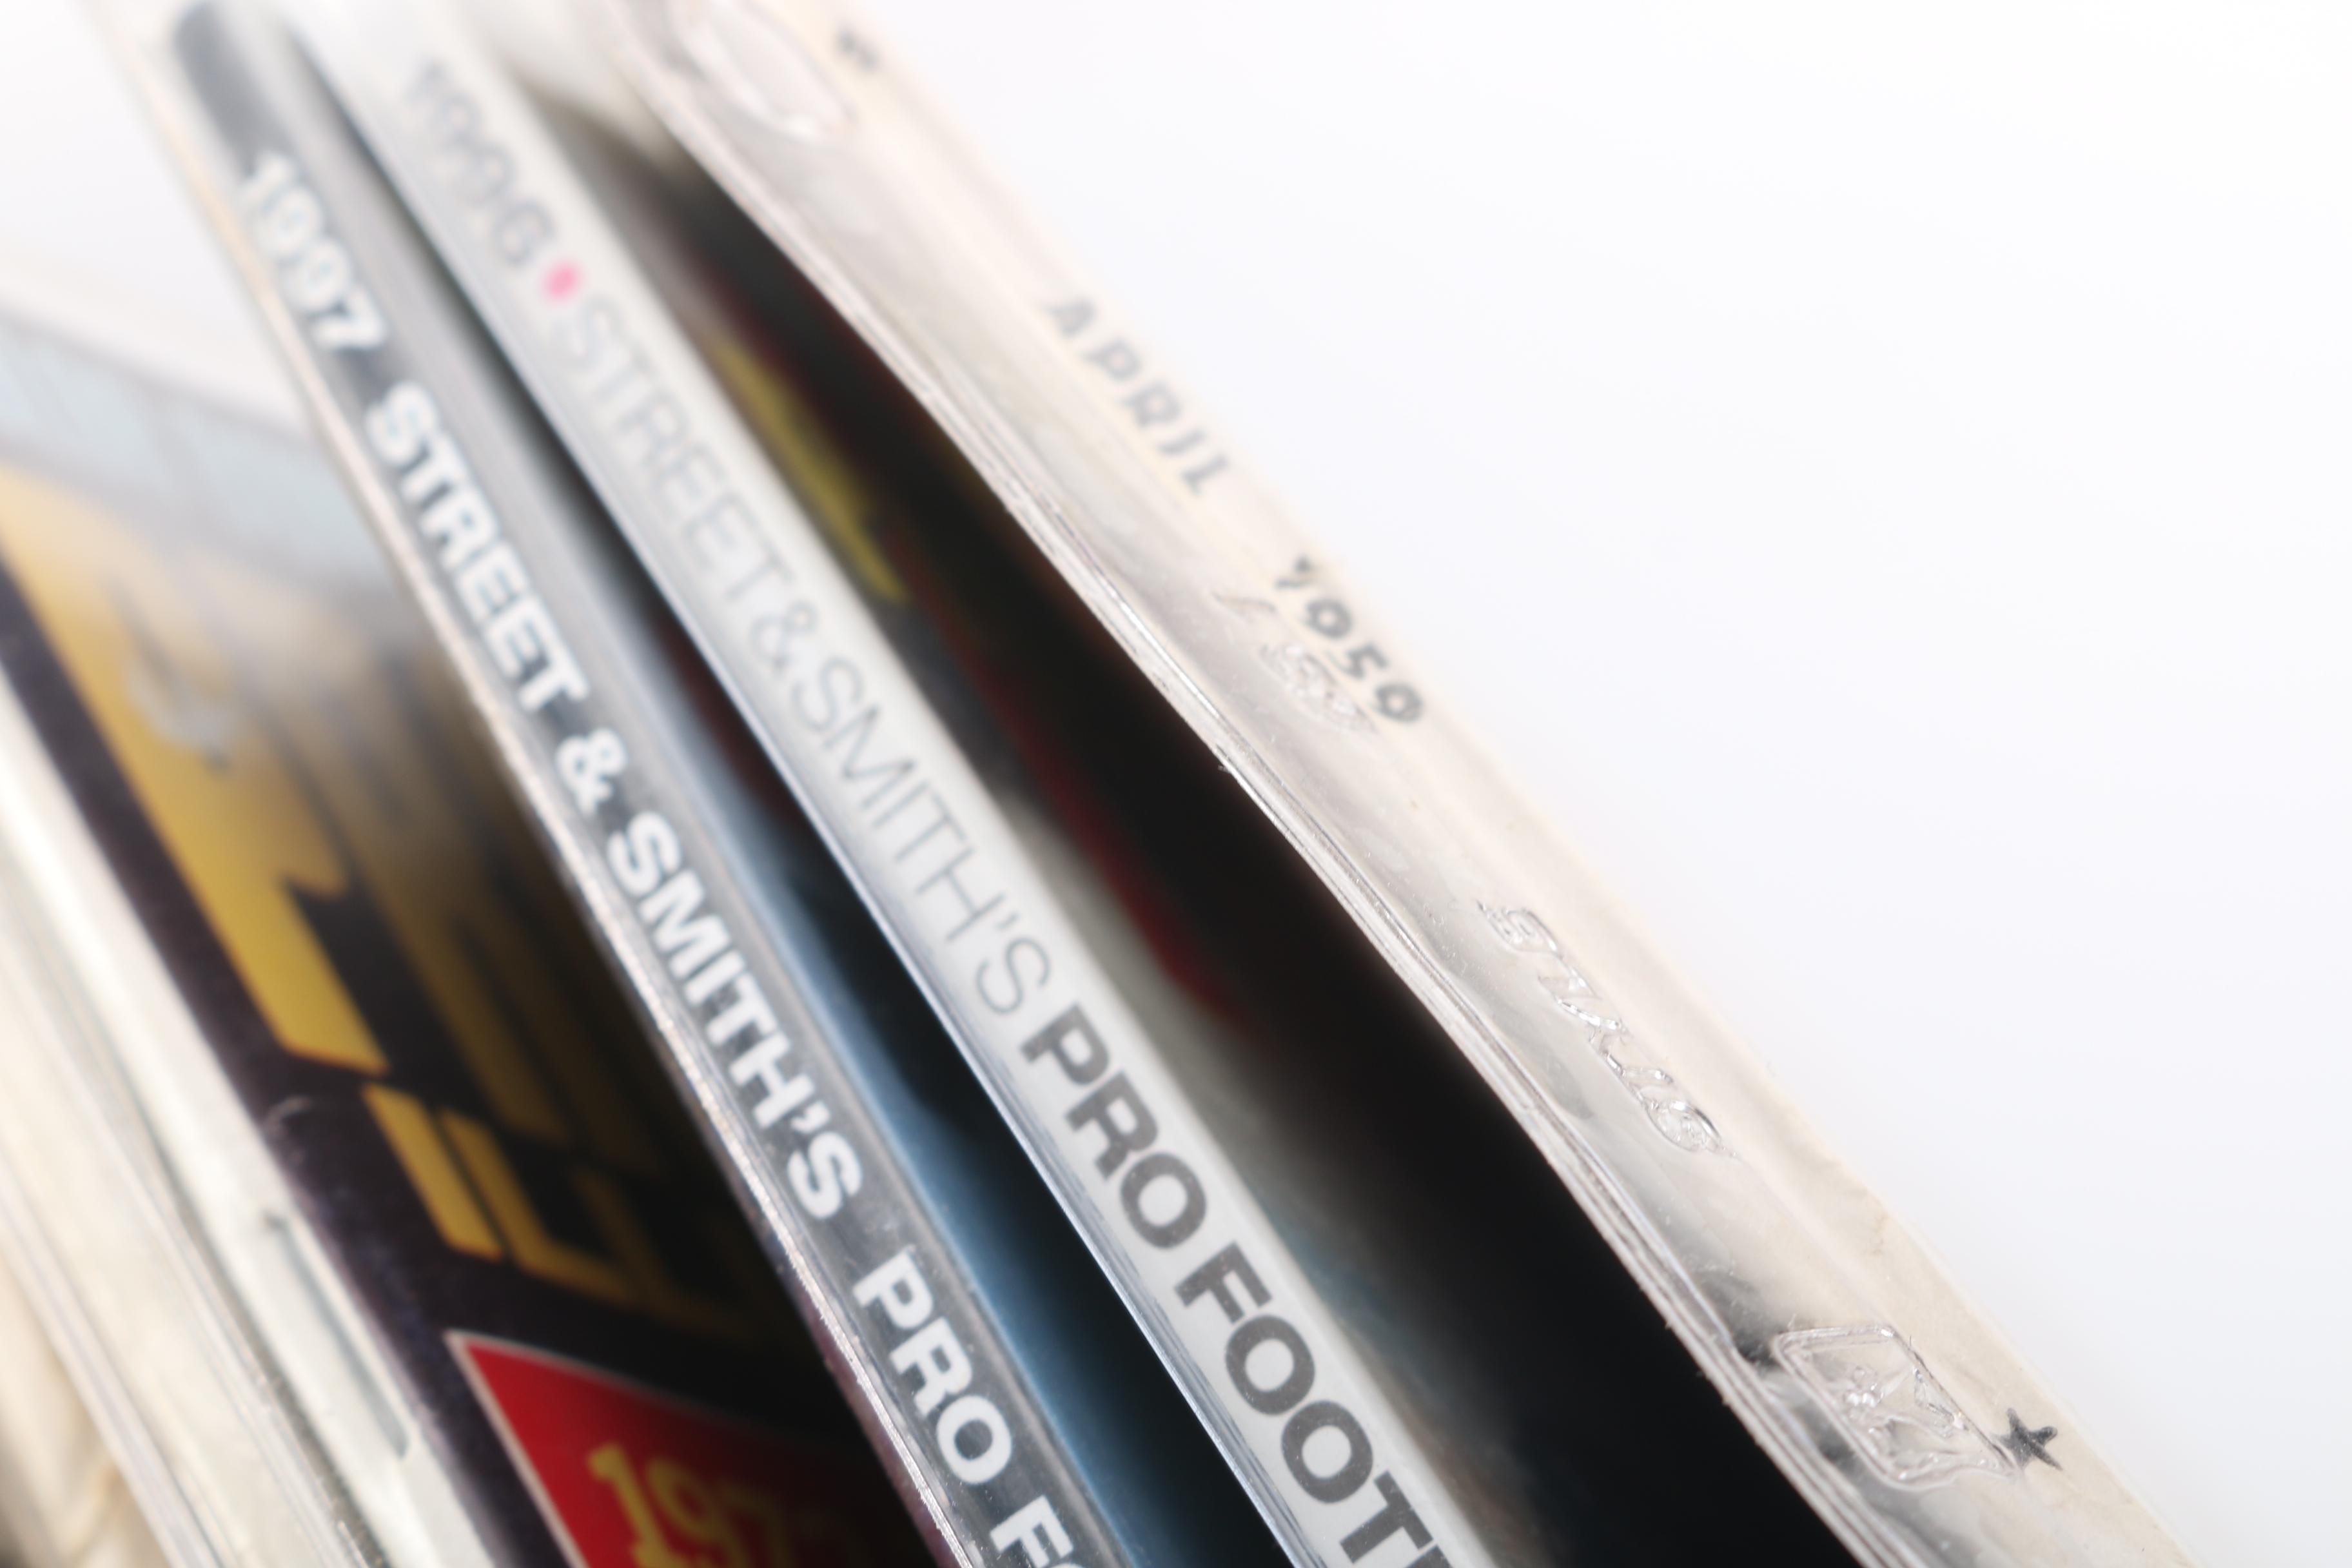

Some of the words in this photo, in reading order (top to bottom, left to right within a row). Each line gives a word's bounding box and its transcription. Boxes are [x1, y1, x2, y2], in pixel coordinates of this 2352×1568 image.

[241, 150, 387, 349] 1997
[365, 381, 590, 712] STREET
[554, 727, 628, 816] &
[606, 811, 863, 1220] SMITH'S
[852, 1251, 1013, 1484] PRO
[407, 59, 556, 264] 1996
[550, 292, 794, 603] STREET
[1019, 1002, 1208, 1250] PRO
[1173, 1241, 1453, 1568] FOOT
[1044, 297, 1229, 496] APRIL
[1275, 553, 1426, 723] 1959
